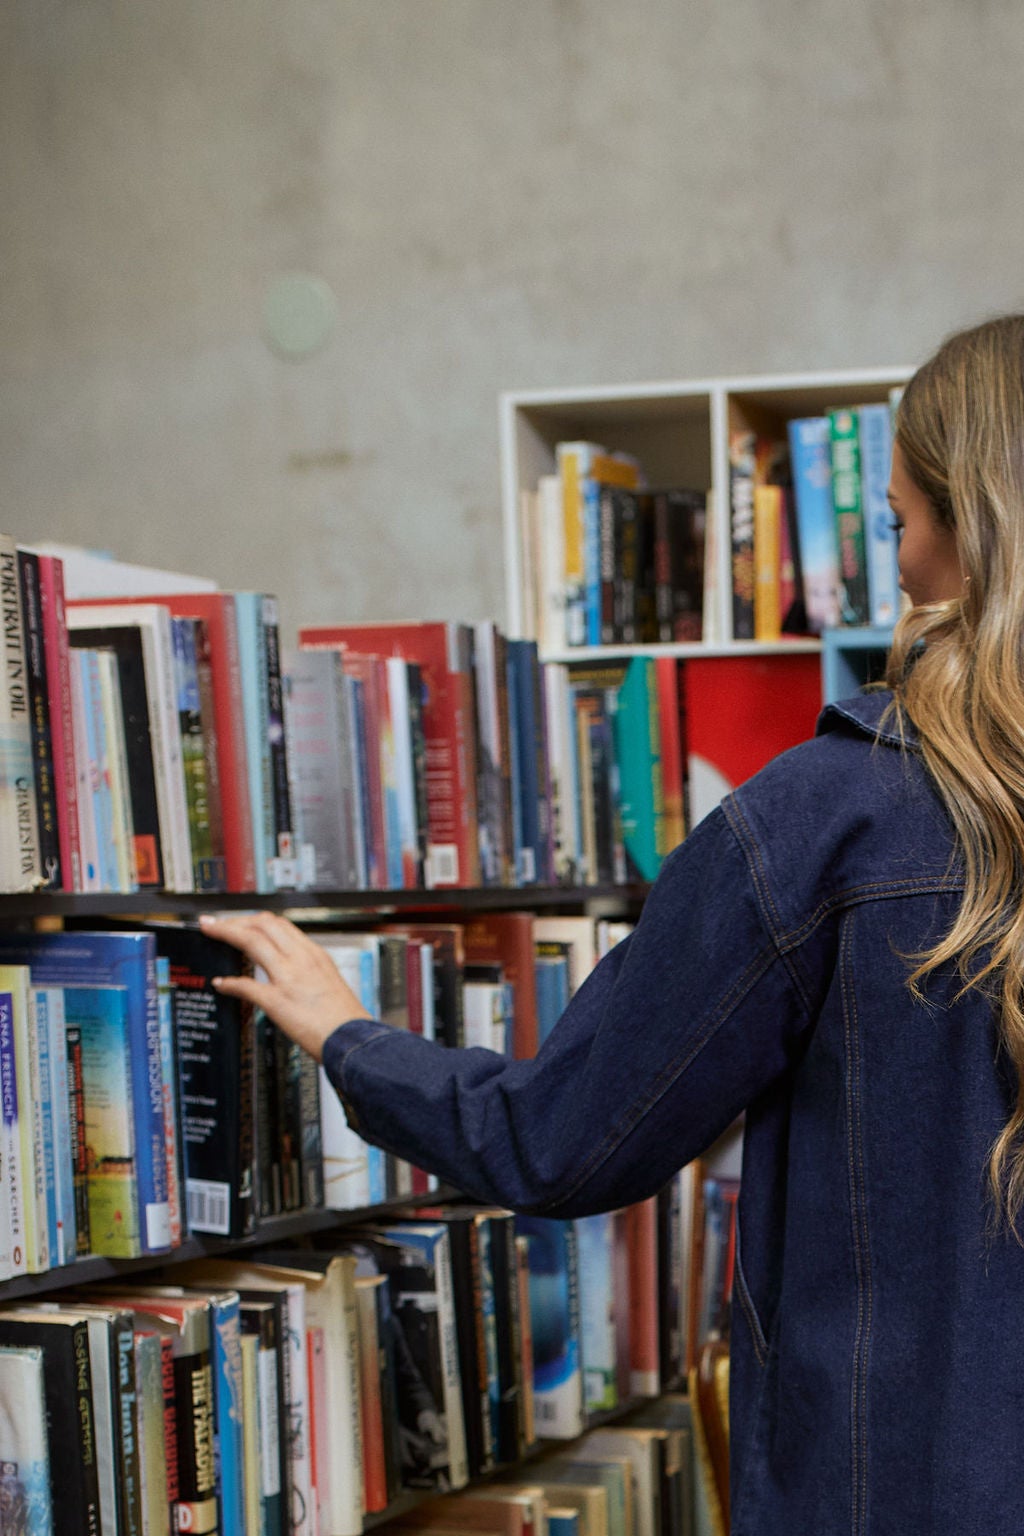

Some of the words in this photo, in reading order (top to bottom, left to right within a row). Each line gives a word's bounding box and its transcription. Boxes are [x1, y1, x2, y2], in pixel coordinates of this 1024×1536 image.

[0, 552, 21, 650] PORTRAIT
[6, 660, 22, 681] IN
[9, 685, 26, 720] OIL
[14, 776, 34, 845] CHARLES
[20, 847, 36, 876] FOX
[0, 1004, 9, 1047] TANA
[145, 988, 163, 1114] INTERMISSION
[1, 1053, 14, 1117] FRENCH
[8, 1155, 21, 1236] SEARCHER
[117, 1330, 135, 1385] Don
[191, 1368, 208, 1405] THE
[120, 1392, 136, 1457] Juan
[163, 1406, 180, 1501] GARDNER
[193, 1407, 212, 1493] PALADIN
